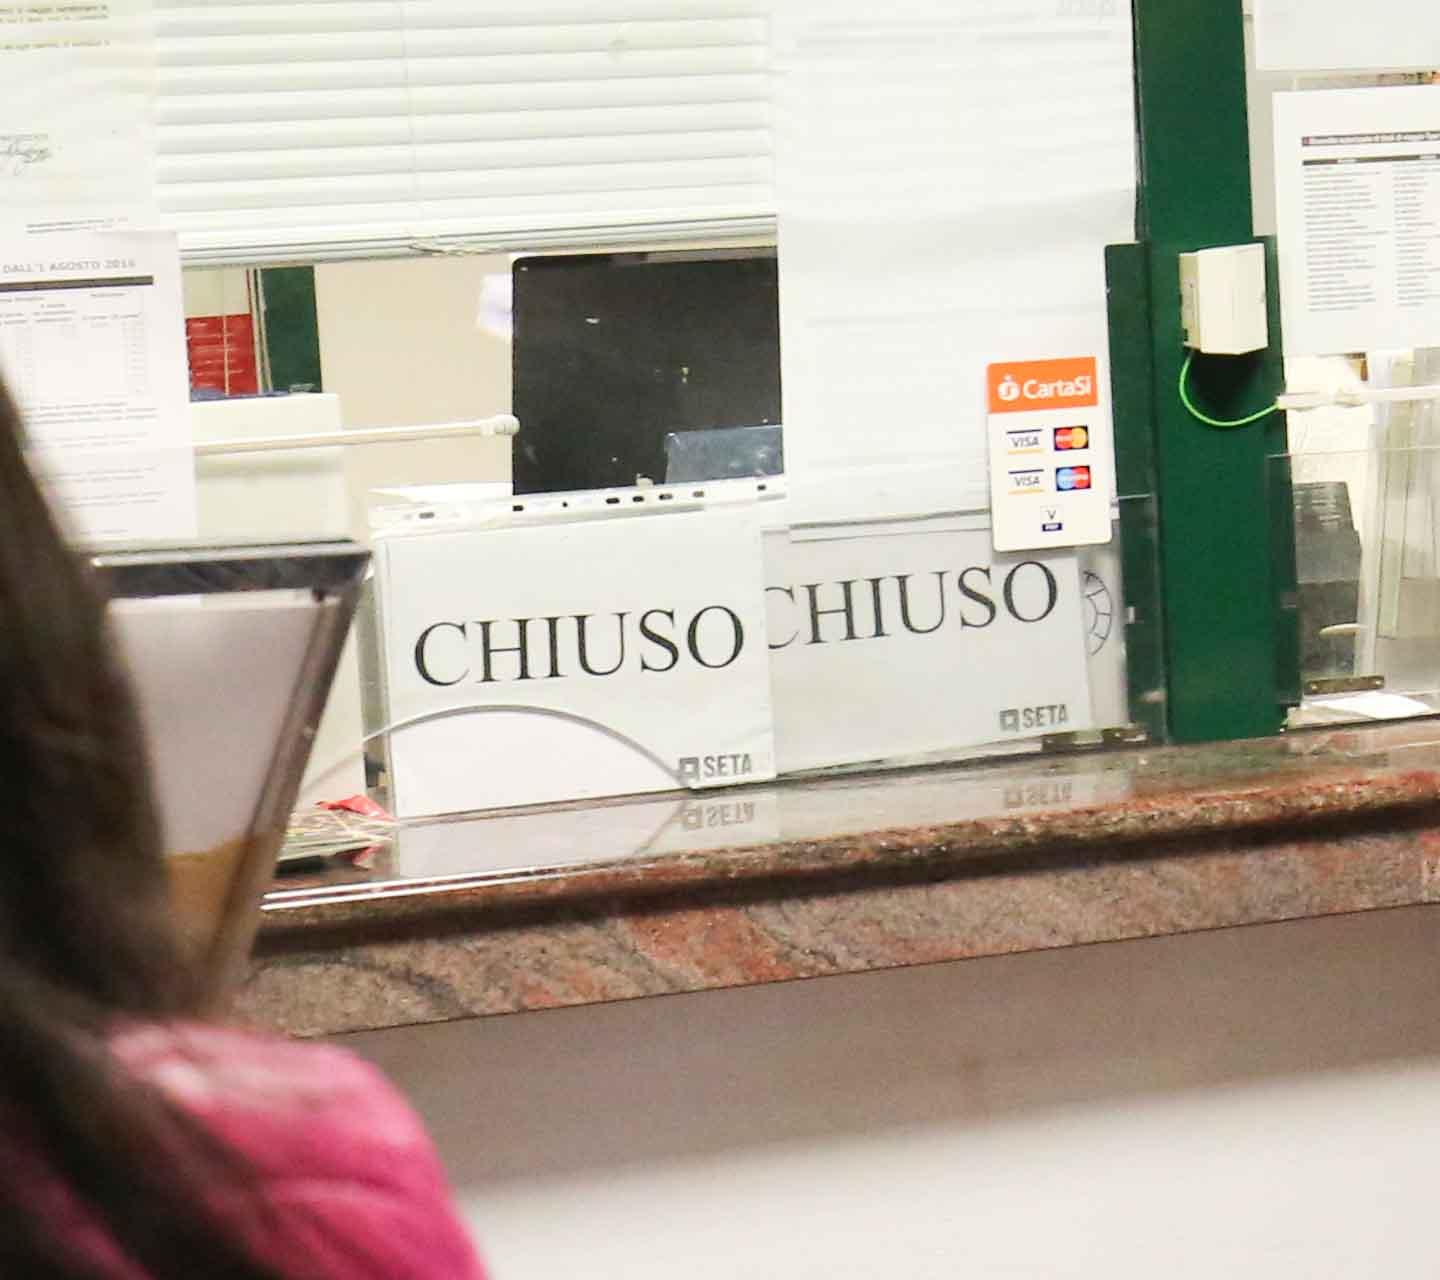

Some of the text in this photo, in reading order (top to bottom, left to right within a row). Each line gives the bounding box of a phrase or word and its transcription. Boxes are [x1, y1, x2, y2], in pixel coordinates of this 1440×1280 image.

[1011, 435, 1040, 448] VISA
[766, 560, 1059, 650] CHIUSO
[414, 605, 745, 687] CHIUSO
[1023, 703, 1069, 730] SETA
[703, 753, 753, 778] SETA
